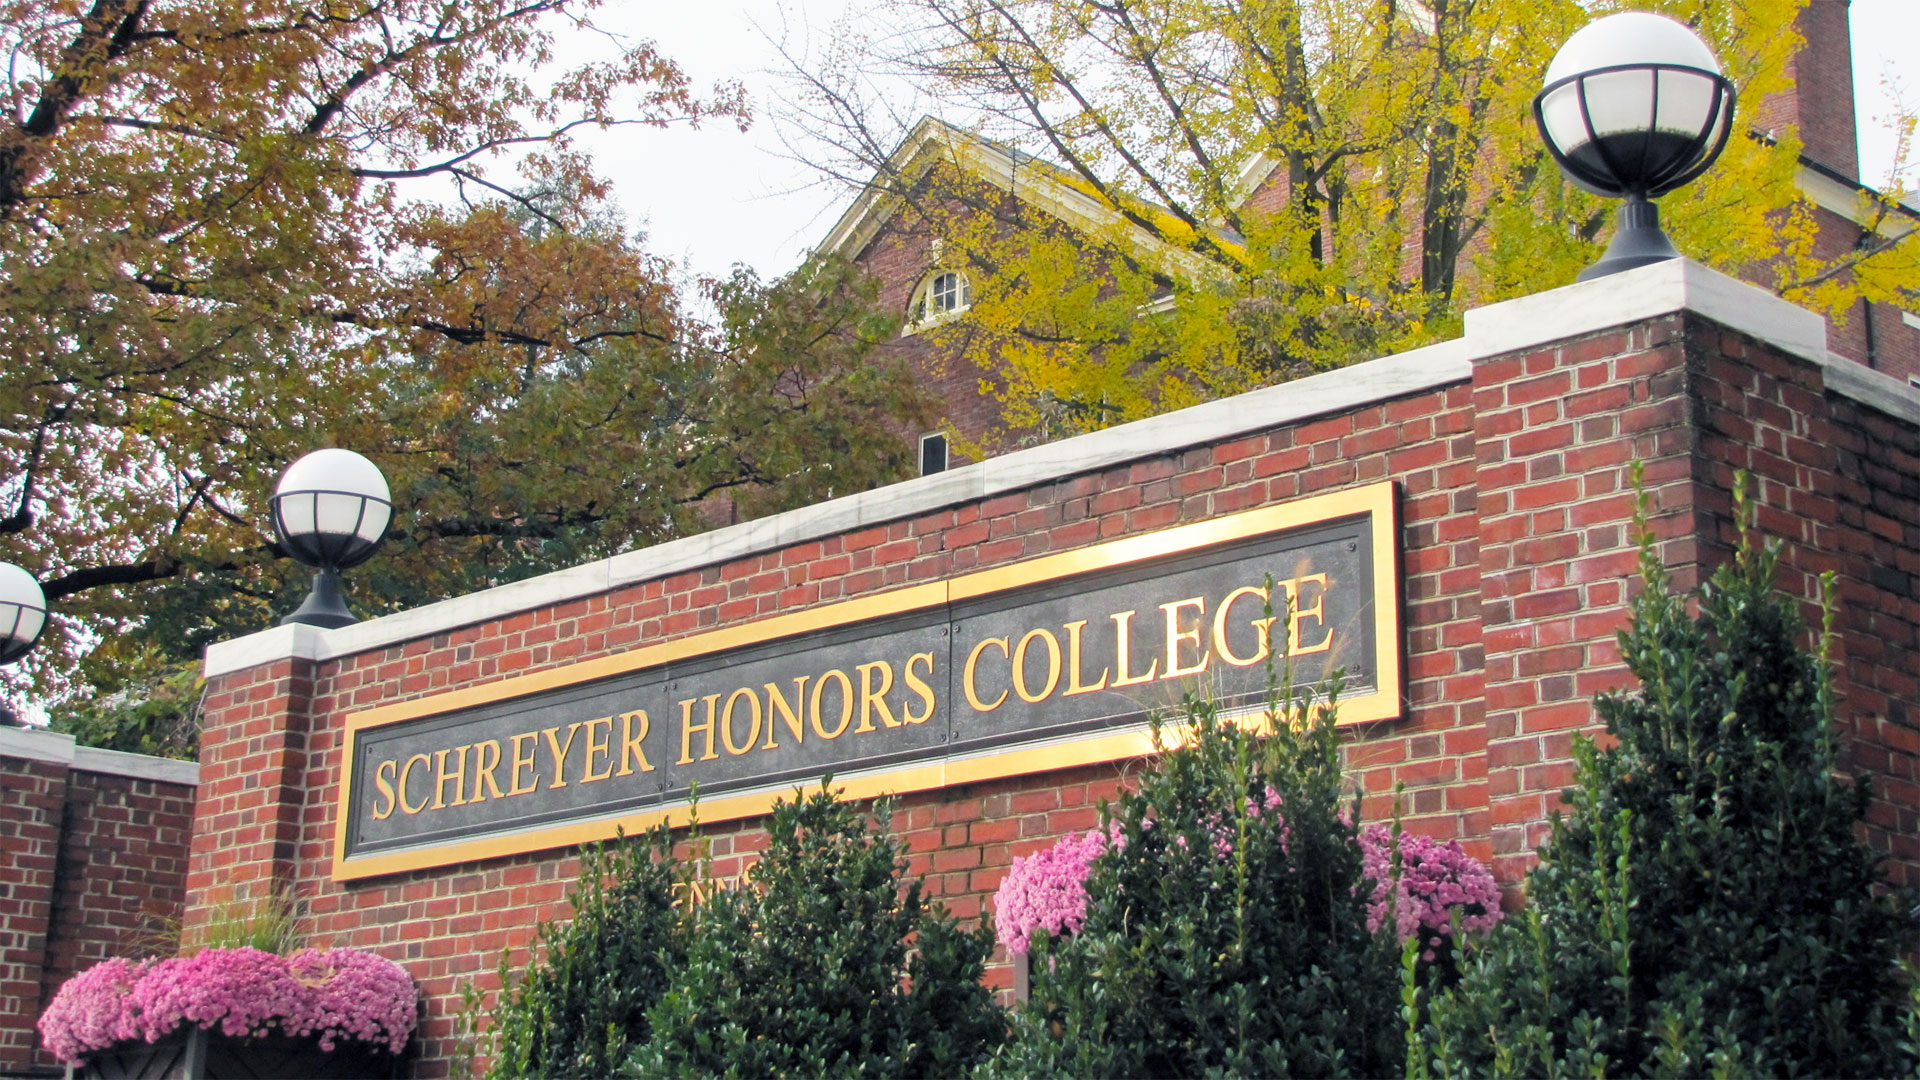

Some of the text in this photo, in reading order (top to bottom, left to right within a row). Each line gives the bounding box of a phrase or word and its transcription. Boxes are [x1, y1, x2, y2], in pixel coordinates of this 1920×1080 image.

[372, 572, 1334, 820] SCHREYER HONORS COLLEGE
